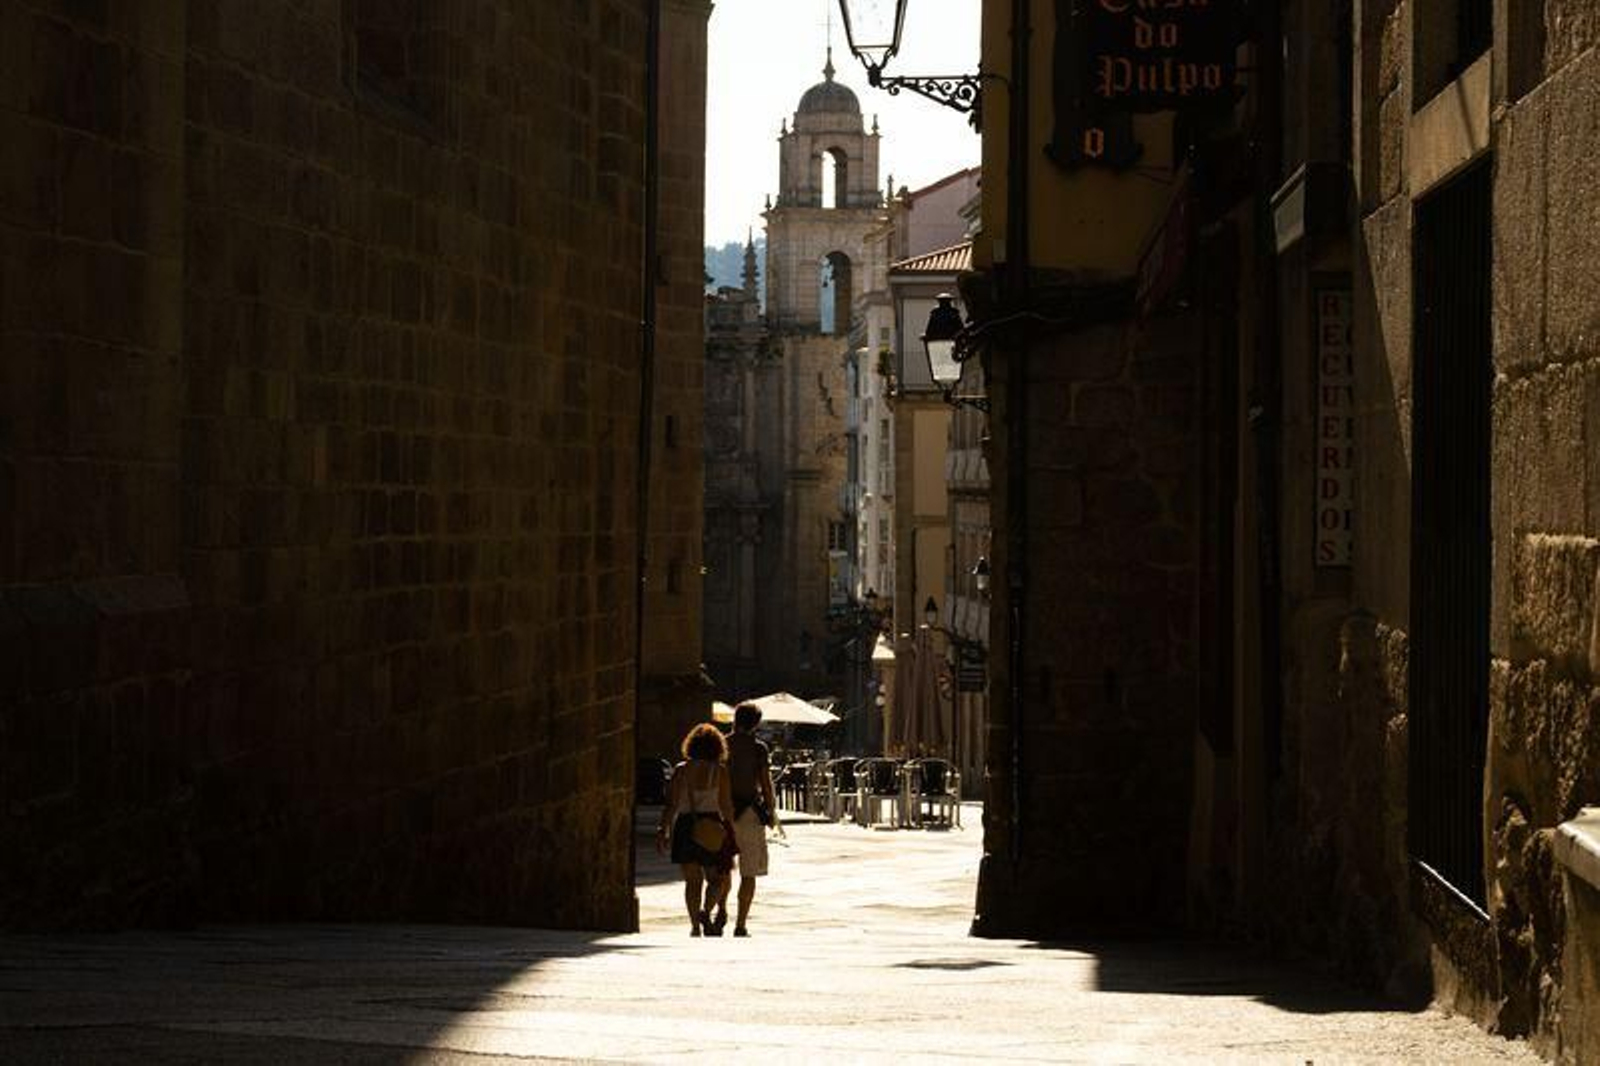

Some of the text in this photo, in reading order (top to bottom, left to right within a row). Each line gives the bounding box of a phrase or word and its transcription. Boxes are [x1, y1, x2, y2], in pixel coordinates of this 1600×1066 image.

[1132, 15, 1178, 48] do
[1094, 53, 1222, 97] Pulpo
[1321, 295, 1341, 561] RECUERDOS
